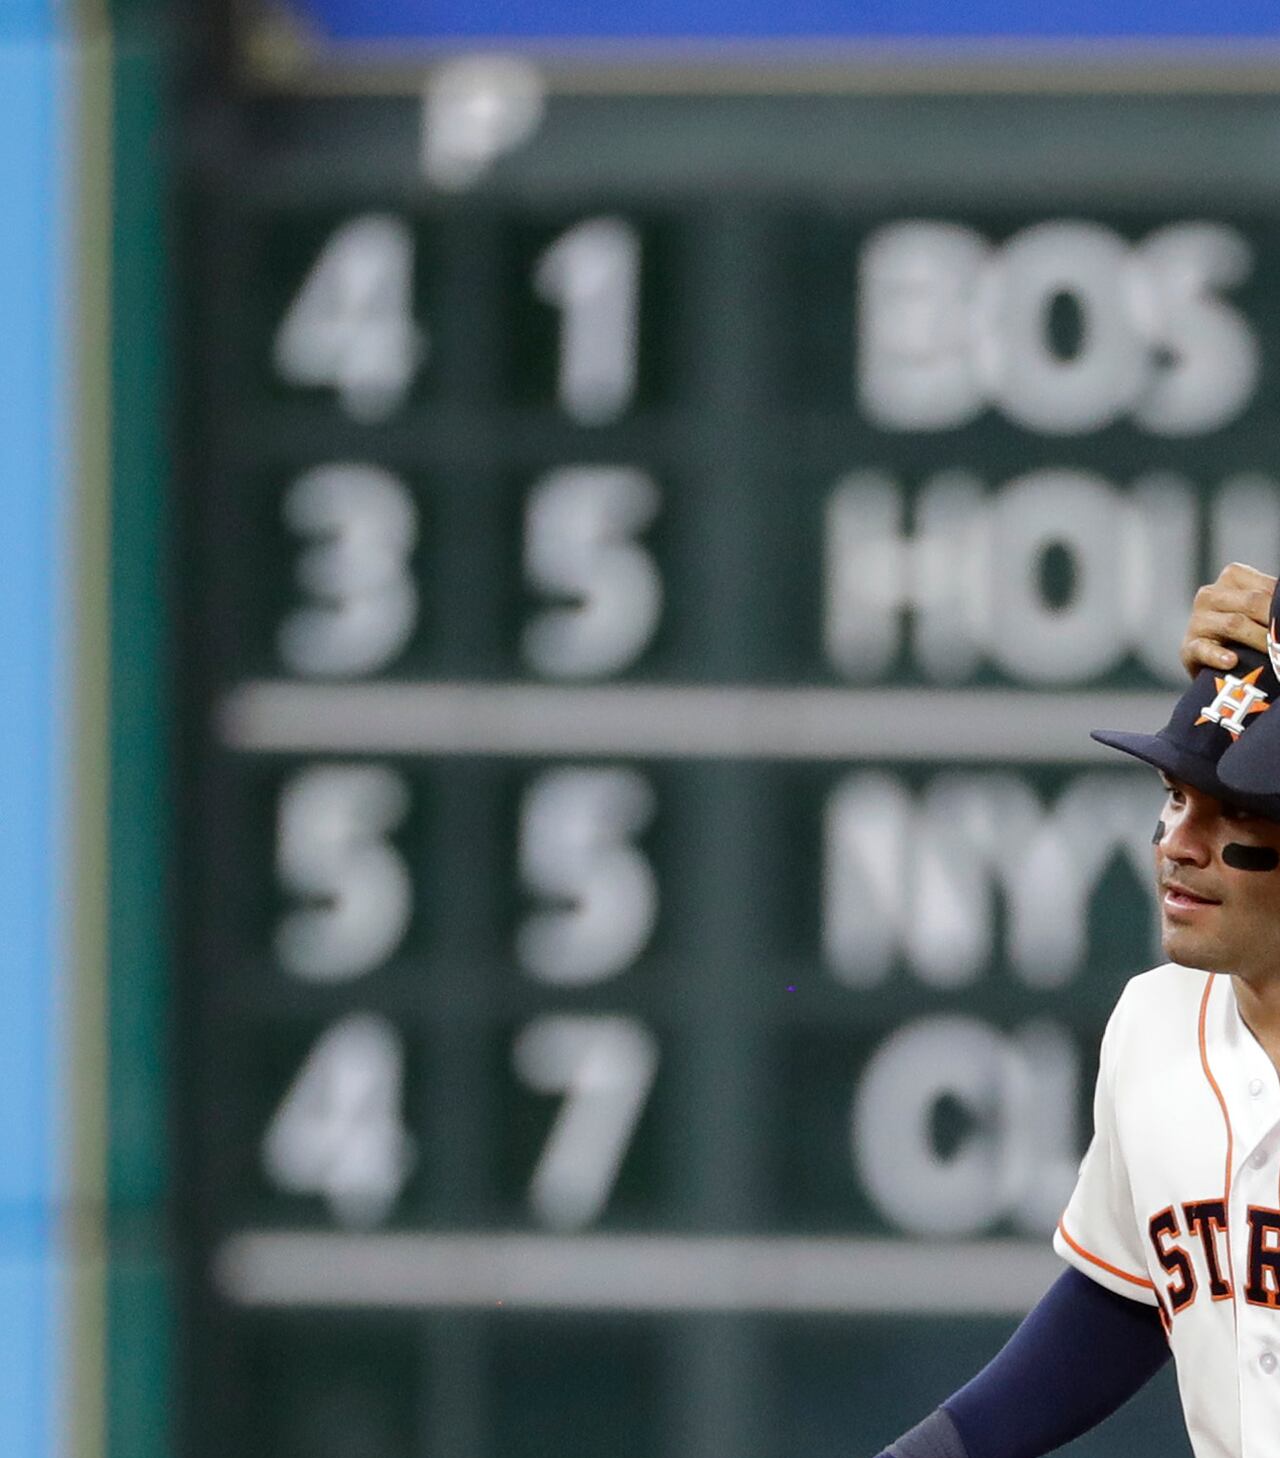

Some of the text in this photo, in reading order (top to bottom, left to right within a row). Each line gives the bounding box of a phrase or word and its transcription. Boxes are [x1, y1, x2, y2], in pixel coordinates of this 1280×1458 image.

[274, 215, 424, 423] 4
[535, 217, 640, 425] 1
[857, 220, 1258, 436] BOS
[278, 462, 418, 679] 3
[522, 465, 662, 680] 5
[276, 764, 412, 984] 5
[518, 766, 657, 986] 5
[262, 1012, 1088, 1235] 4 7 CL
